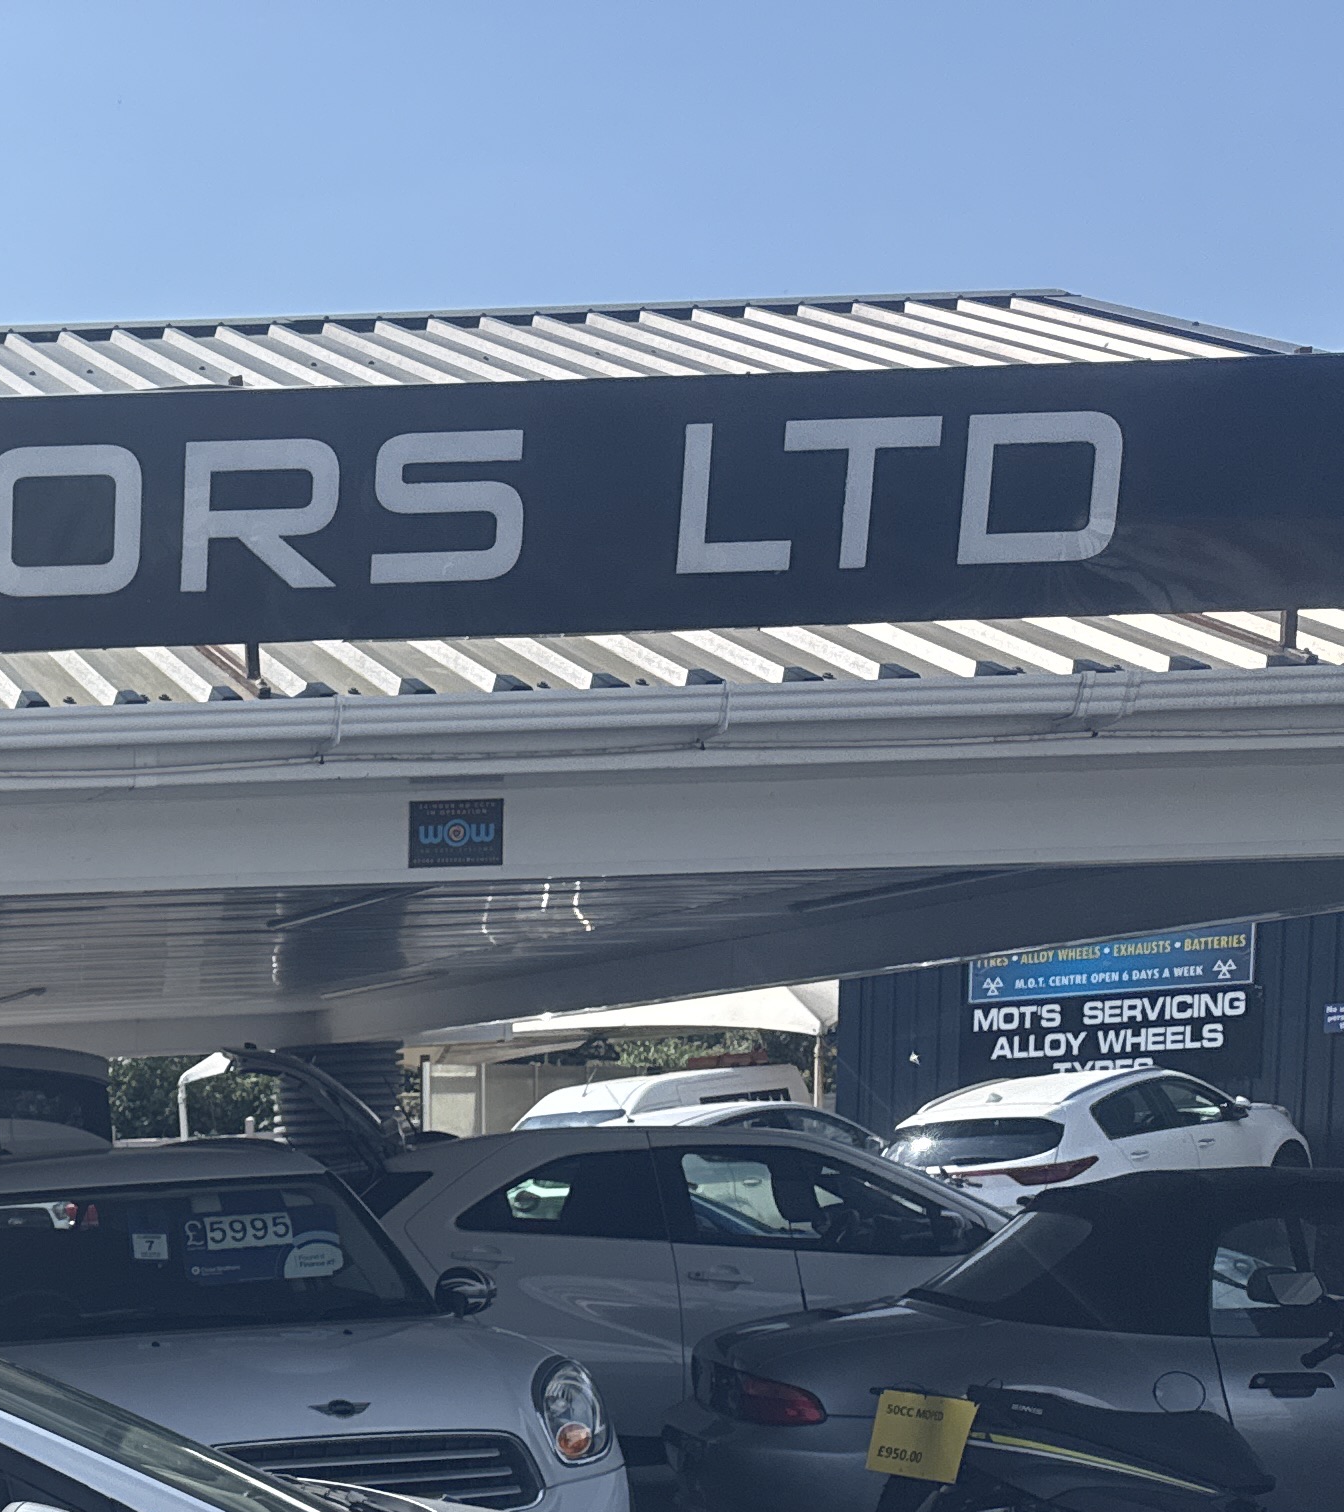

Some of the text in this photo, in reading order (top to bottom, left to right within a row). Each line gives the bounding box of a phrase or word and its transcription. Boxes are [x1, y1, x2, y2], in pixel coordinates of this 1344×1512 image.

[676, 411, 1123, 574] LTD
[1020, 950, 1054, 965] ALLOY
[1058, 946, 1100, 961] WHEELS
[1113, 940, 1171, 957] EXHAUSTS
[1184, 934, 1247, 951] BATTERIES
[1049, 973, 1087, 987] CENTRE
[1091, 970, 1119, 983] OPEN
[1122, 970, 1129, 981] 6
[1132, 967, 1159, 980] DAYS
[1162, 968, 1170, 978] A
[1173, 965, 1203, 977] WEEK
[973, 991, 1246, 1032] MOT'S SERVICING
[991, 1023, 1223, 1060] ALLOY WHEELS
[185, 1215, 290, 1246] £5995
[886, 1404, 914, 1418] 50CC
[877, 1445, 922, 1464] £950.00
